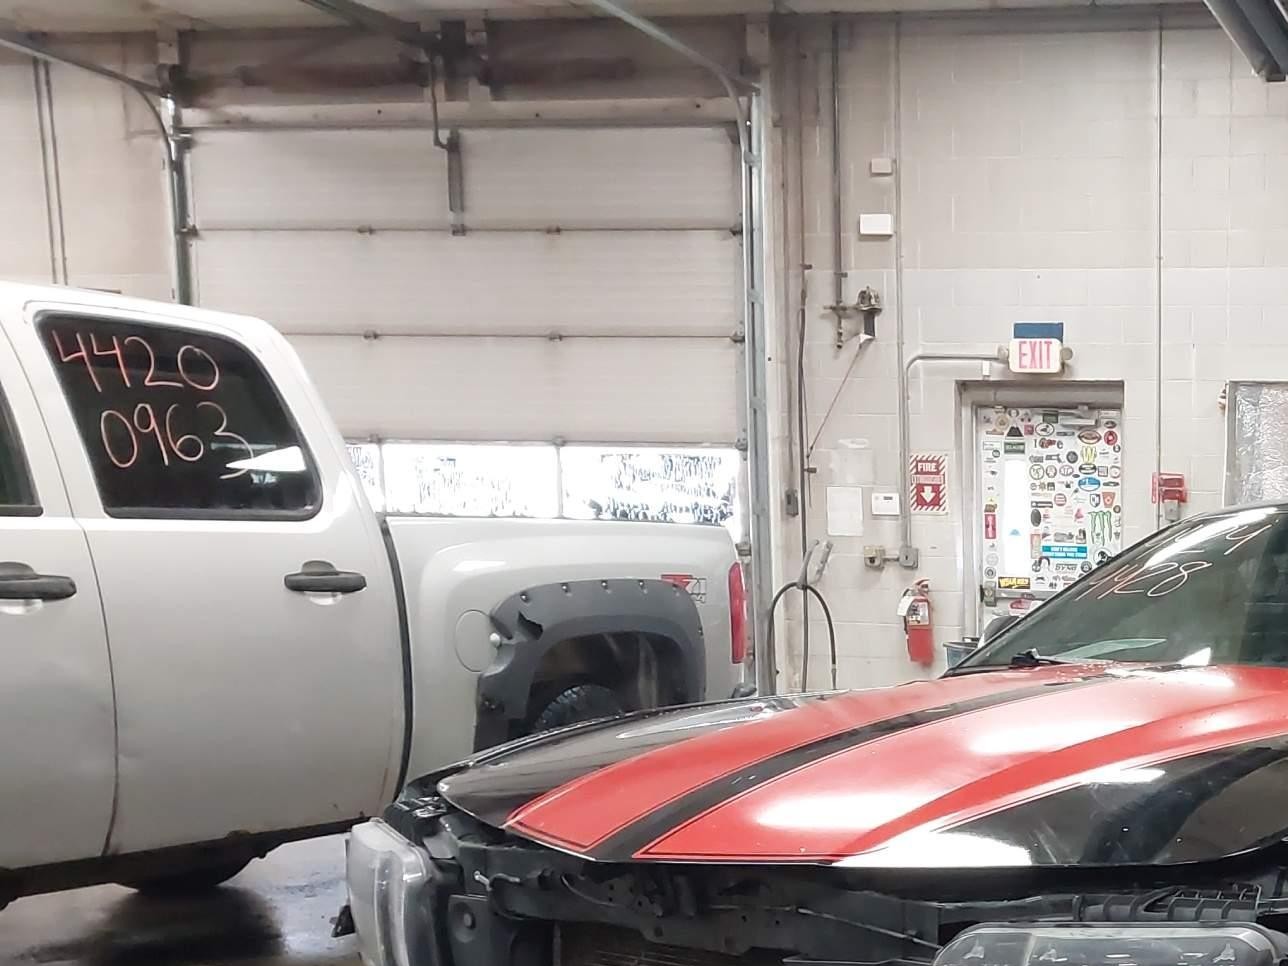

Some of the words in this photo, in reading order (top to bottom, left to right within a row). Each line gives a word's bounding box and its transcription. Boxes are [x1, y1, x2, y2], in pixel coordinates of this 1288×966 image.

[52, 330, 219, 393] 4420
[1018, 340, 1053, 369] EXIT
[99, 401, 255, 480] 0963
[917, 462, 938, 472] FIRE
